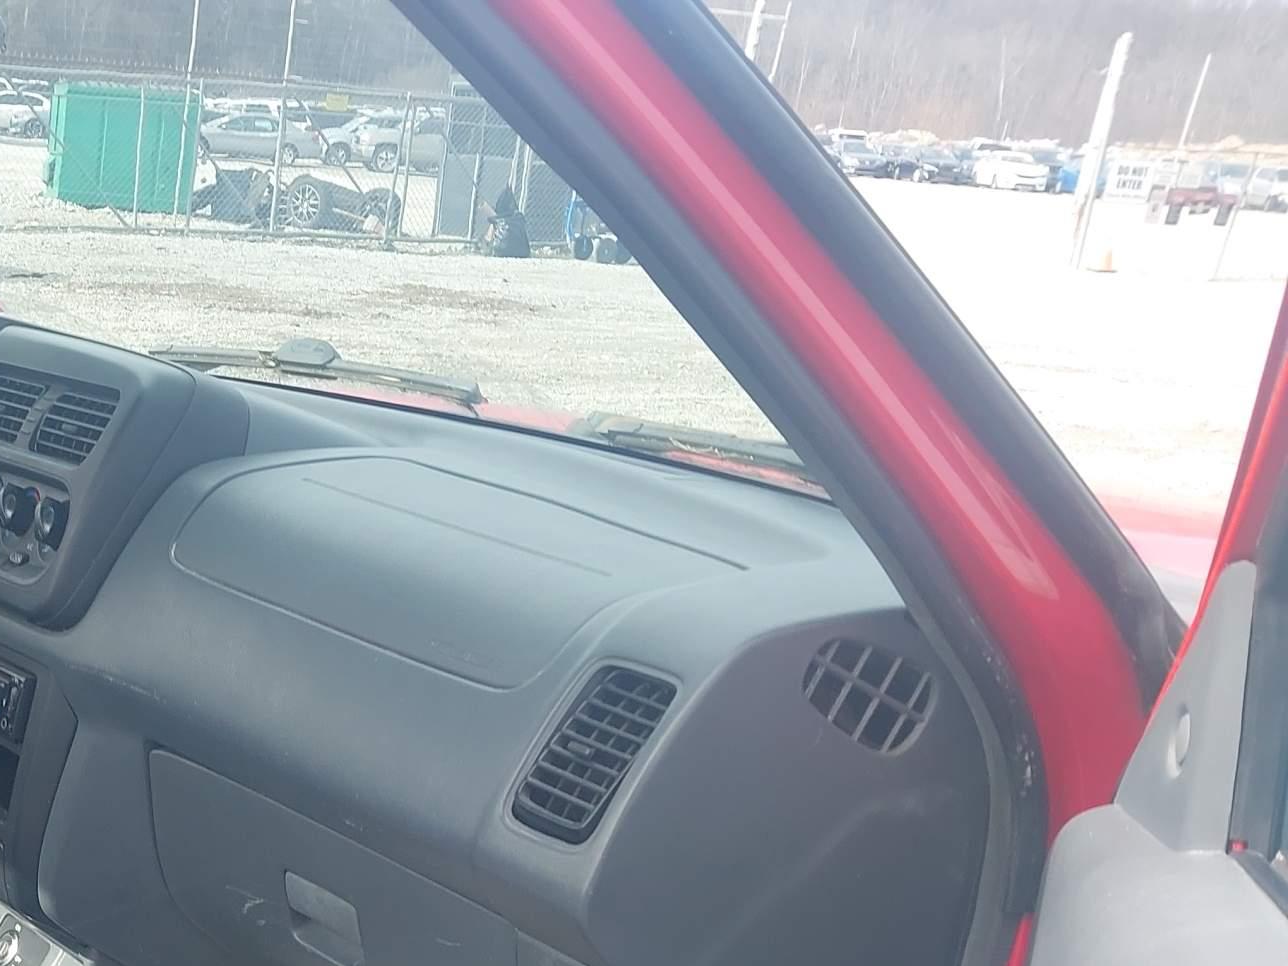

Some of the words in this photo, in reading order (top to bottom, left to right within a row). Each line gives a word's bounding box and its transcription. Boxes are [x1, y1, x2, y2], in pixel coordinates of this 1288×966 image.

[1117, 165, 1130, 176] DO
[1131, 166, 1150, 177] NOT
[1116, 177, 1143, 190] ENTER
